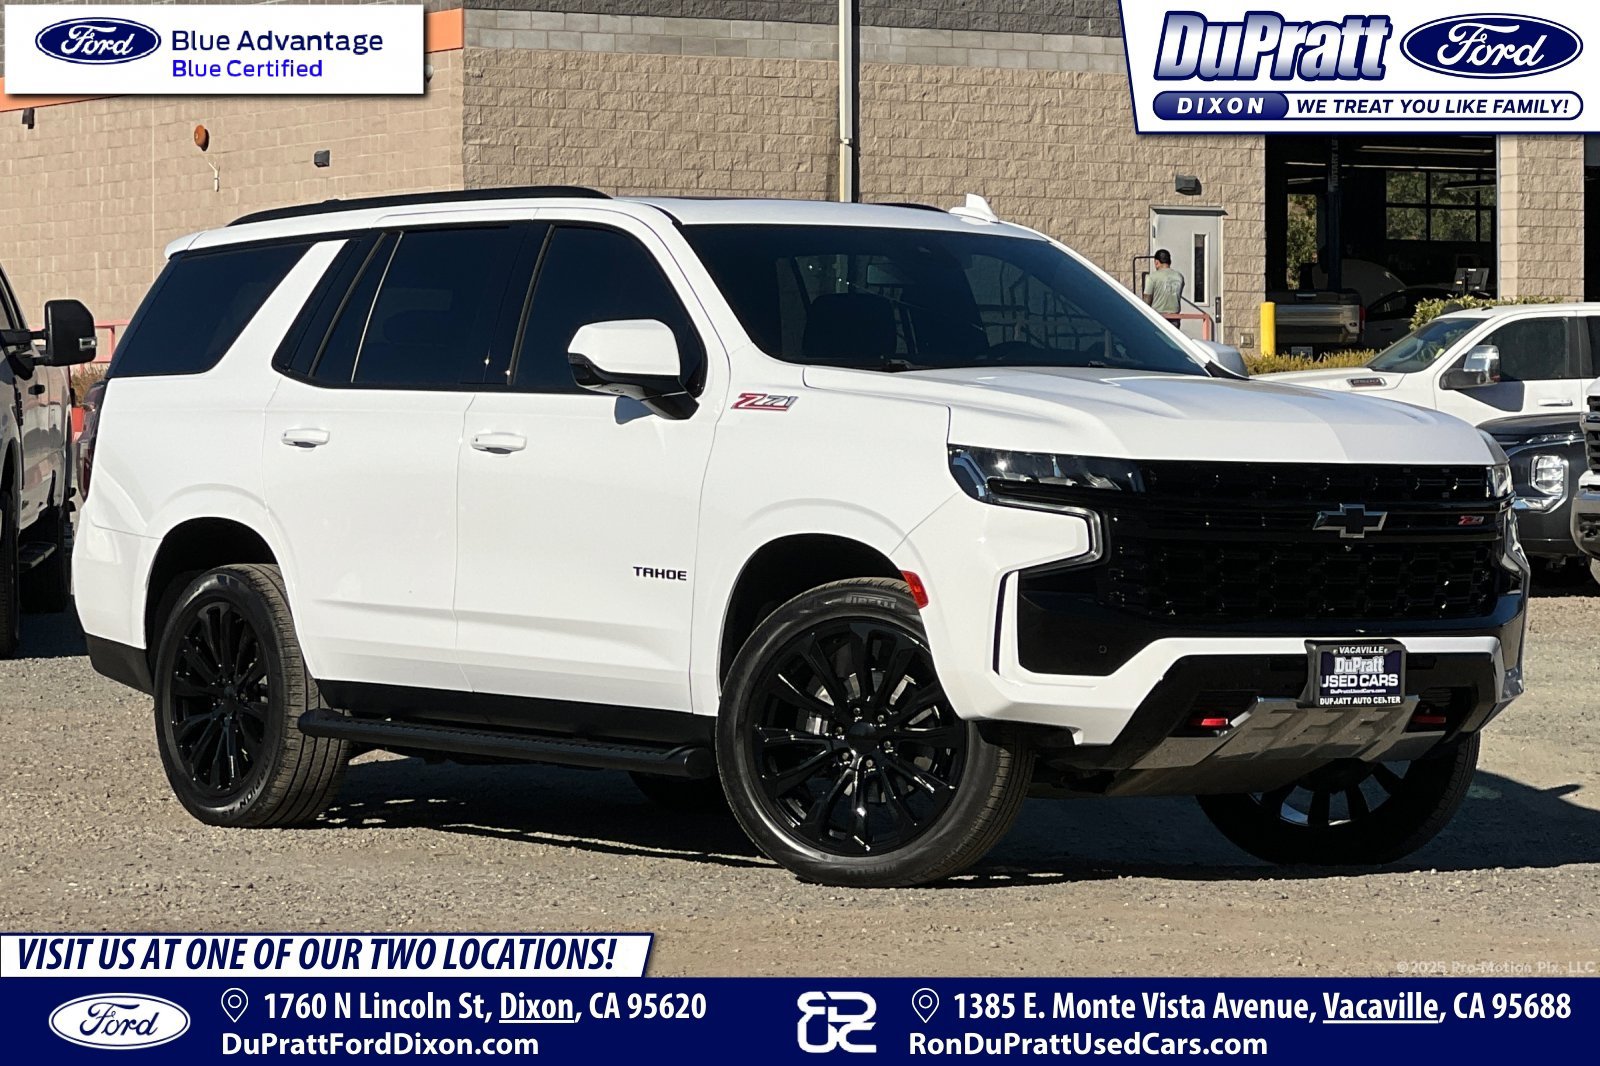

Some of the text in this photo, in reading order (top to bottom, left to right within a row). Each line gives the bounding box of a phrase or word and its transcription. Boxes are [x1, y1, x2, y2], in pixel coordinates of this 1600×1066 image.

[633, 566, 687, 581] TAHOE
[1339, 646, 1384, 654] VACAVILLE
[1333, 655, 1384, 674] DuPratt
[1359, 673, 1399, 687] CARS
[1353, 696, 1372, 705] AUTO
